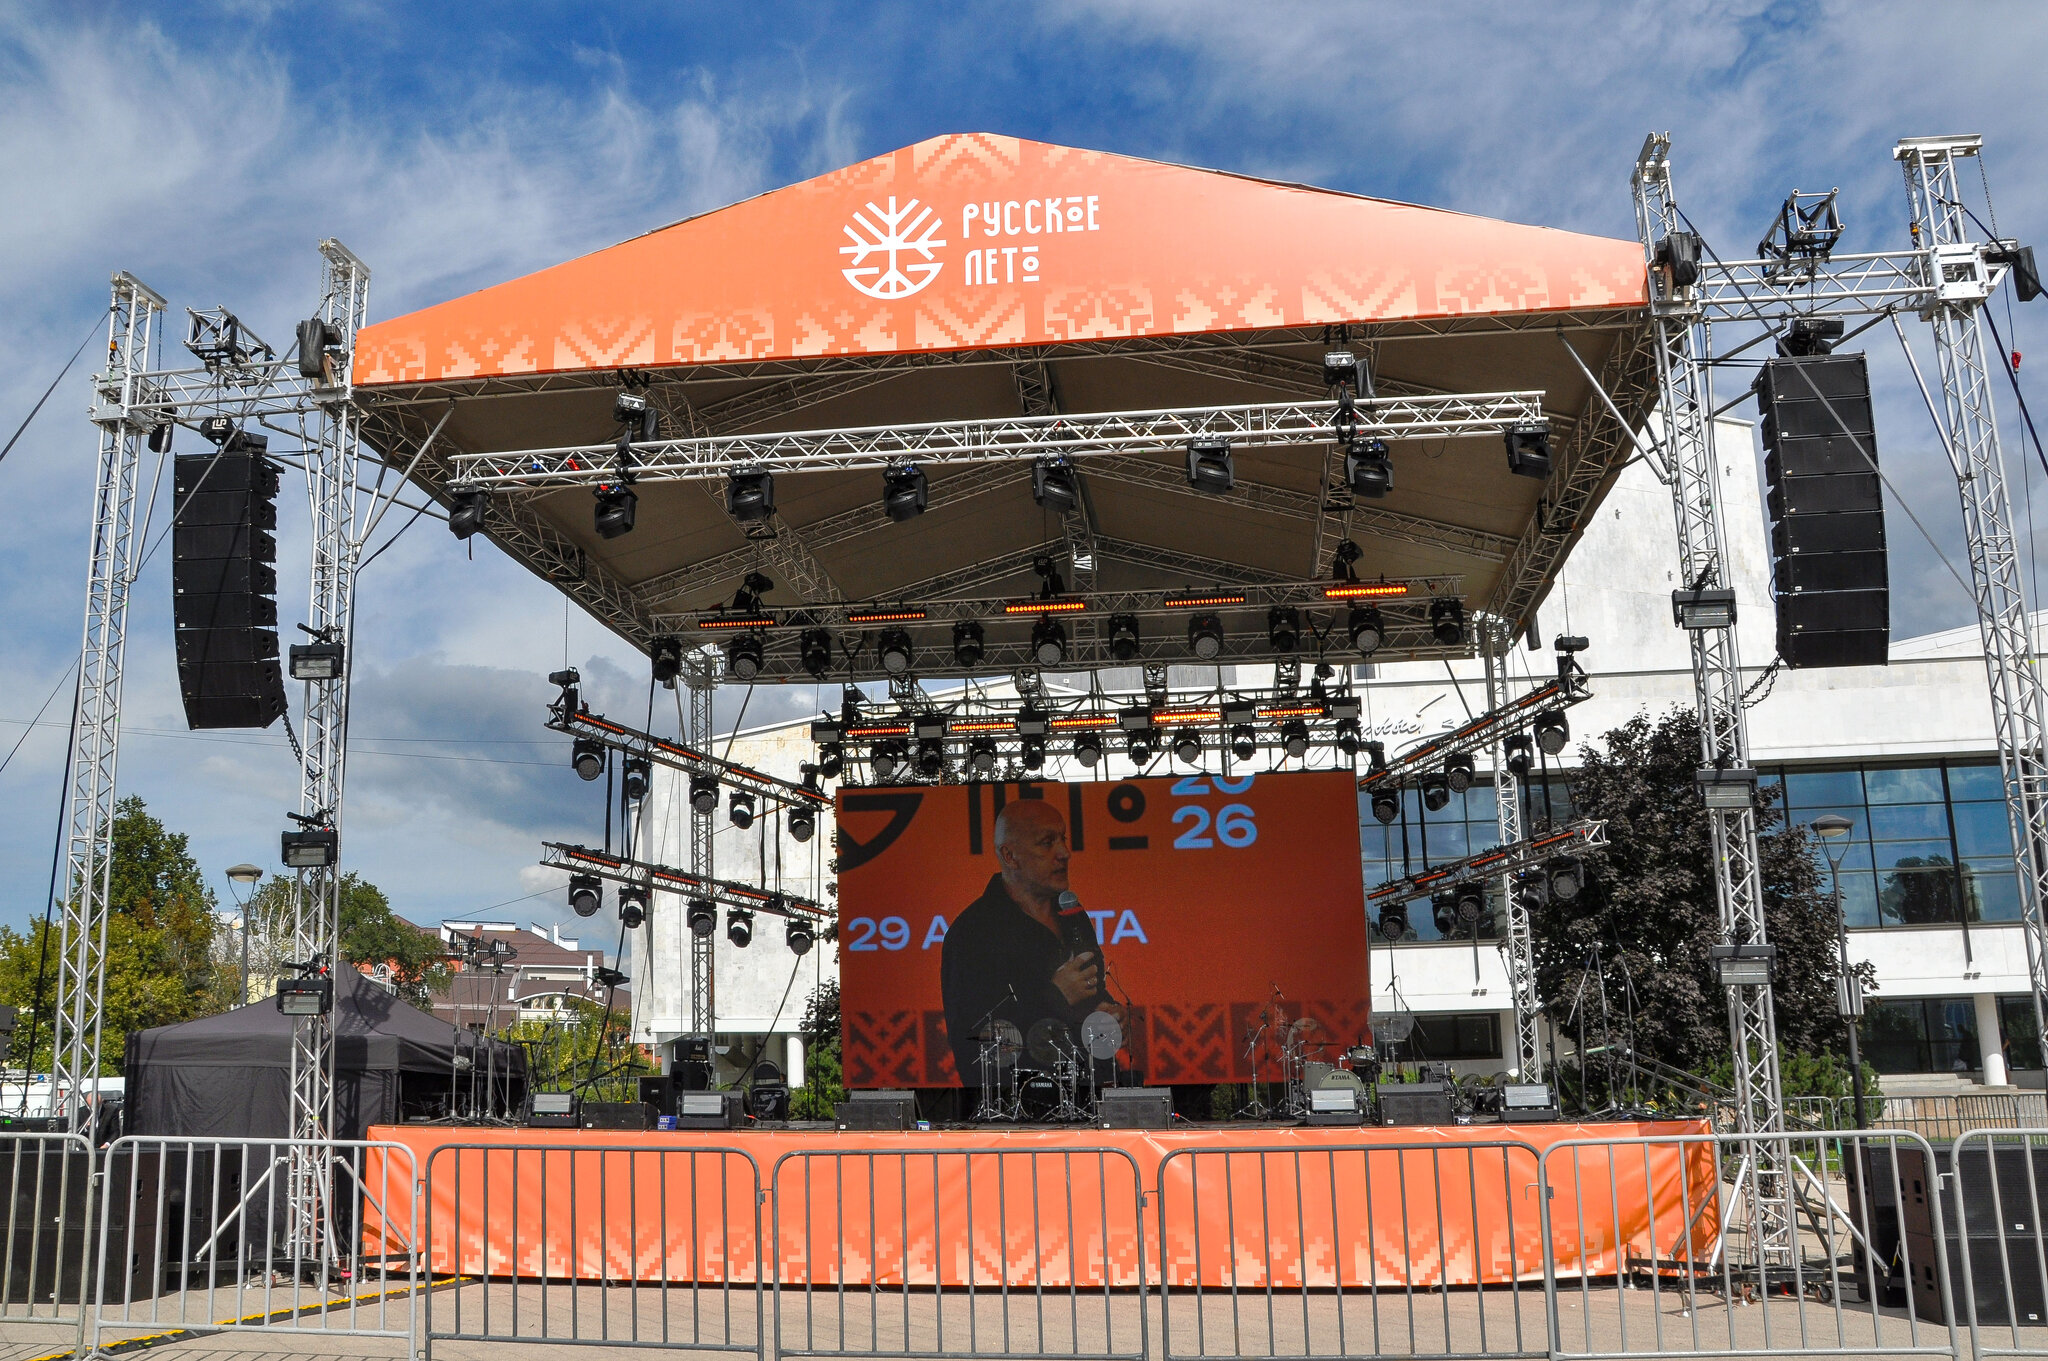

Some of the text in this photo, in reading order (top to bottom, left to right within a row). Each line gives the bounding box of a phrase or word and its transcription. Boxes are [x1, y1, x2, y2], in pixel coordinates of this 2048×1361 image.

[963, 195, 1099, 238] РУССКОЕ
[965, 246, 1039, 286] ЛЕТО
[1171, 803, 1258, 849] 26
[848, 915, 910, 951] 29
